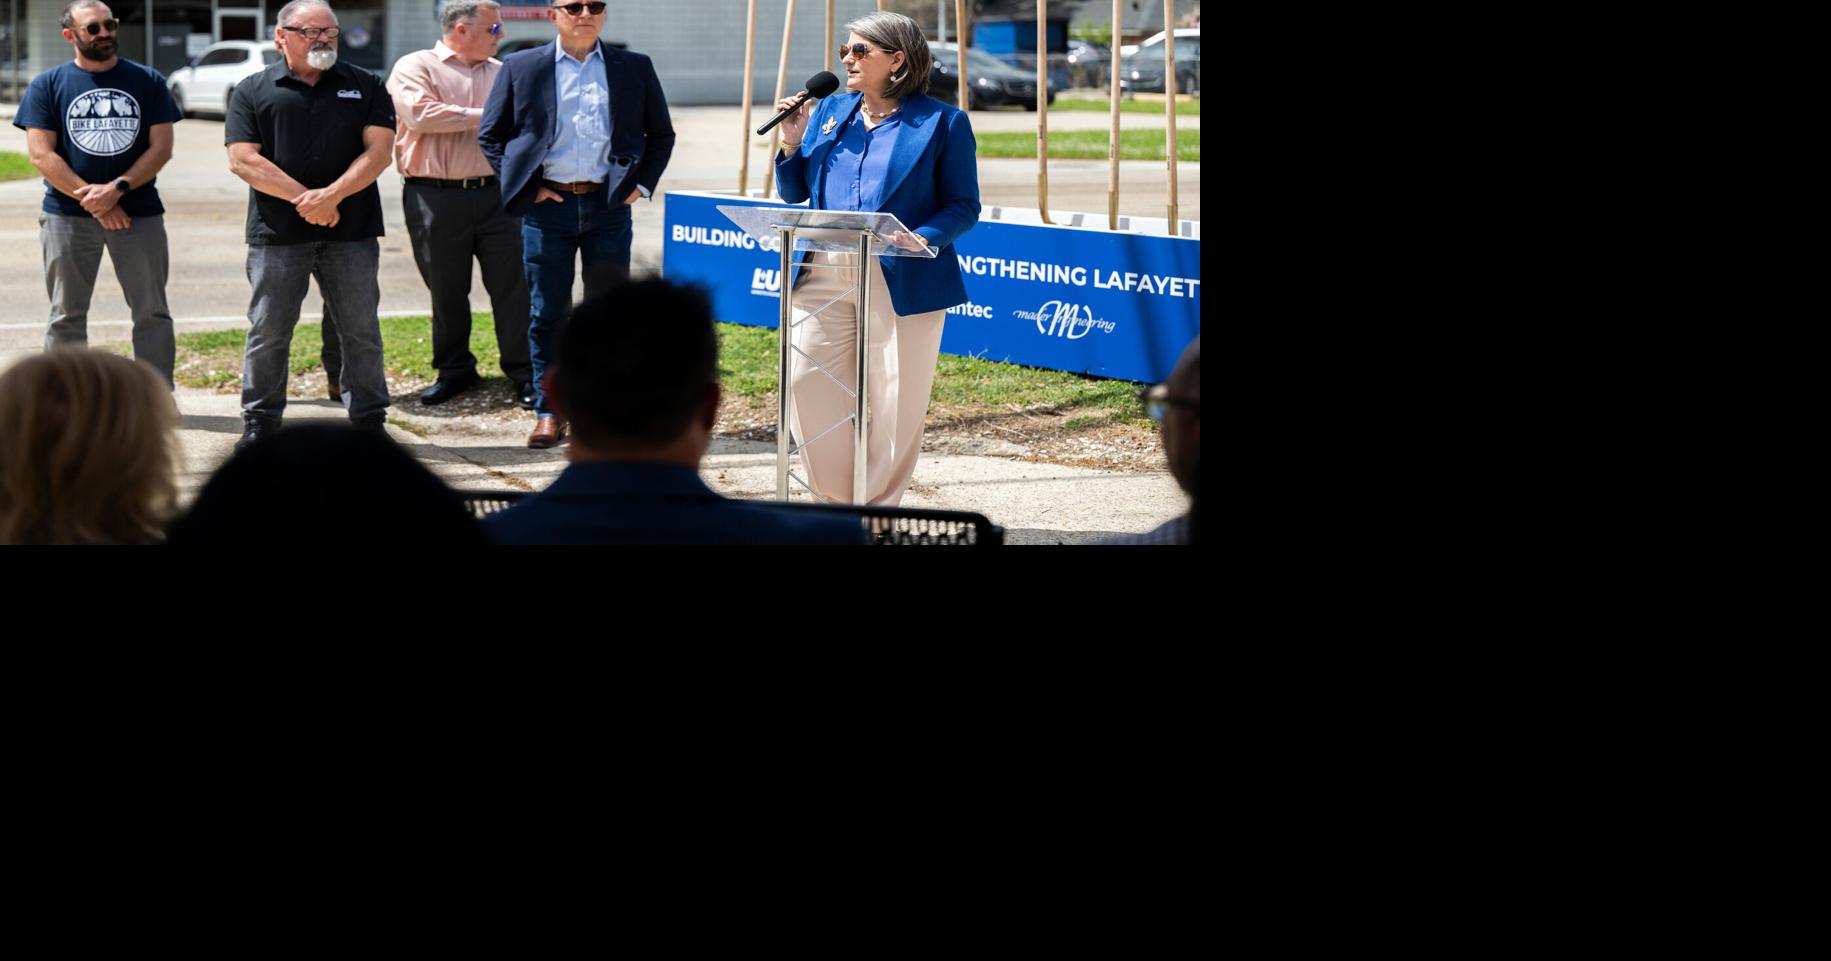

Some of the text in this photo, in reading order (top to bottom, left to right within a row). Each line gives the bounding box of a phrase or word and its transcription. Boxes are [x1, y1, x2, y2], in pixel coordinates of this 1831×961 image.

[72, 119, 136, 129] BIKE LAFAYETTE
[672, 224, 755, 249] BUILDING
[1094, 268, 1200, 298] LAFAYET
